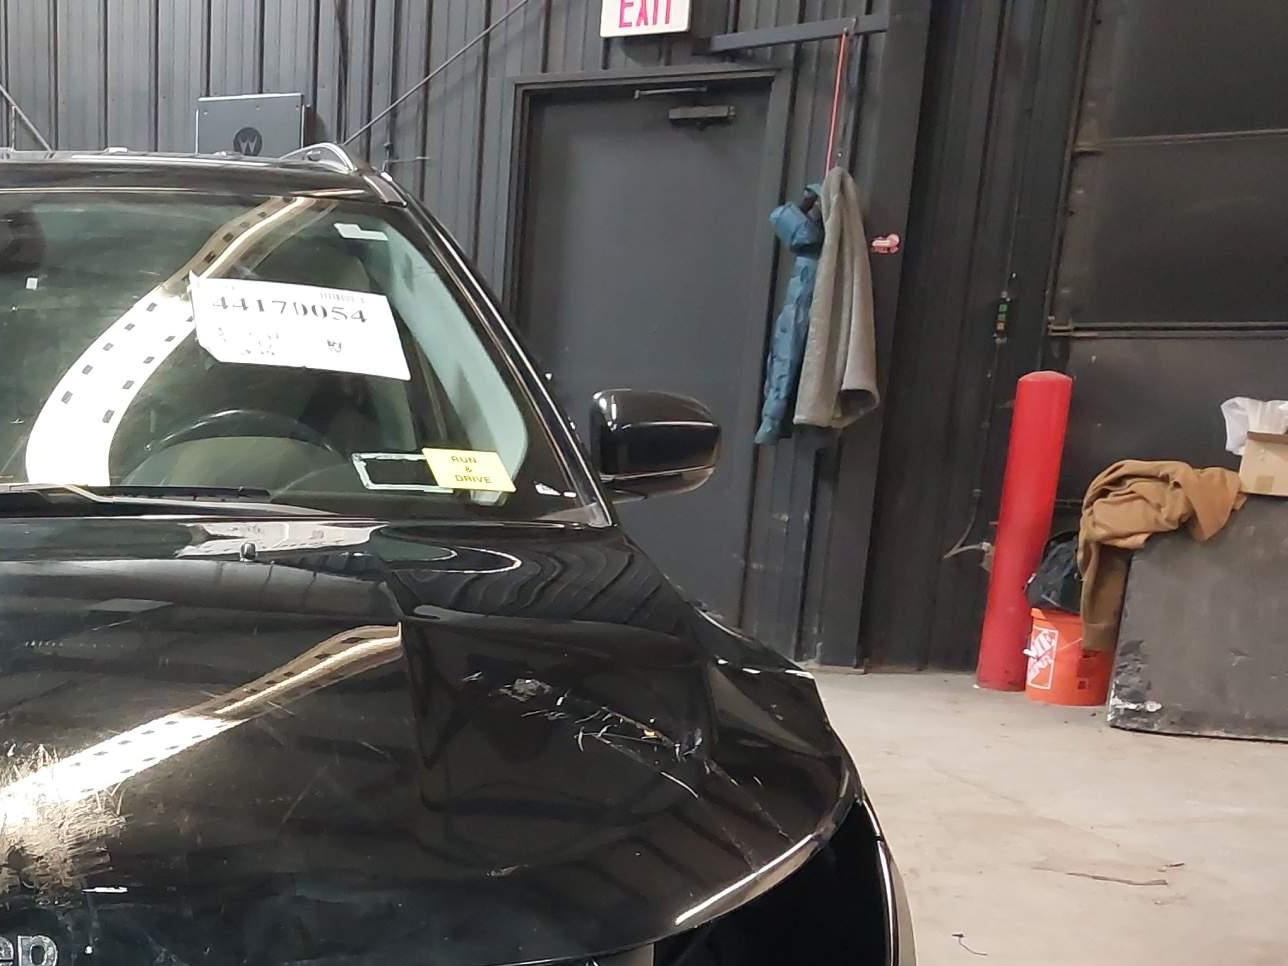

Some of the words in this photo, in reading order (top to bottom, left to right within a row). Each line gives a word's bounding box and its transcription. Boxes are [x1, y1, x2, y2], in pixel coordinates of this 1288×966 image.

[618, 0, 672, 28] EXIT
[450, 455, 478, 464] RUN
[454, 474, 492, 484] DRIVE
